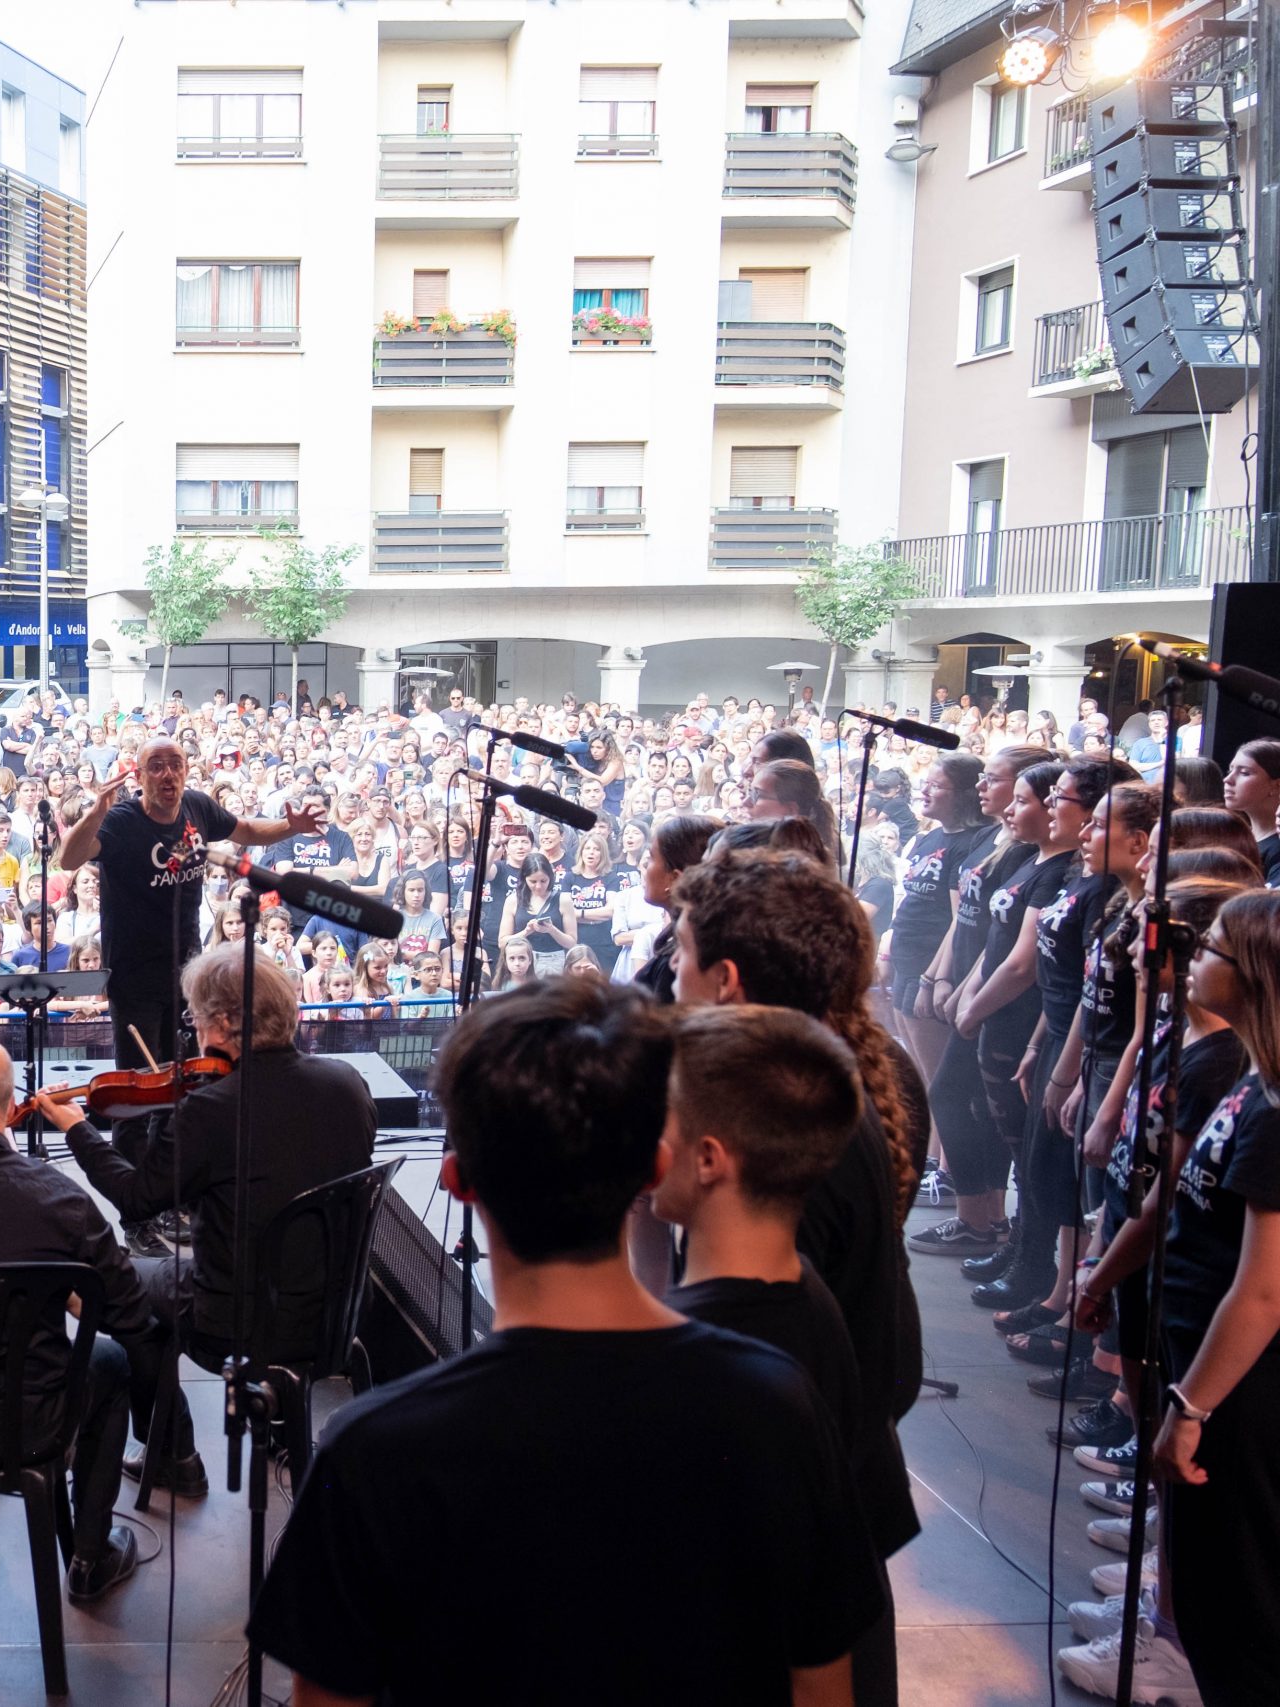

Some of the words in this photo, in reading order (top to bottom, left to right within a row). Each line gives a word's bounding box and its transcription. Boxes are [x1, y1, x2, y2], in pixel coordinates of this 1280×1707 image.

[9, 623, 43, 636] d'Andor
[54, 623, 62, 635] la
[67, 623, 87, 635] Vella
